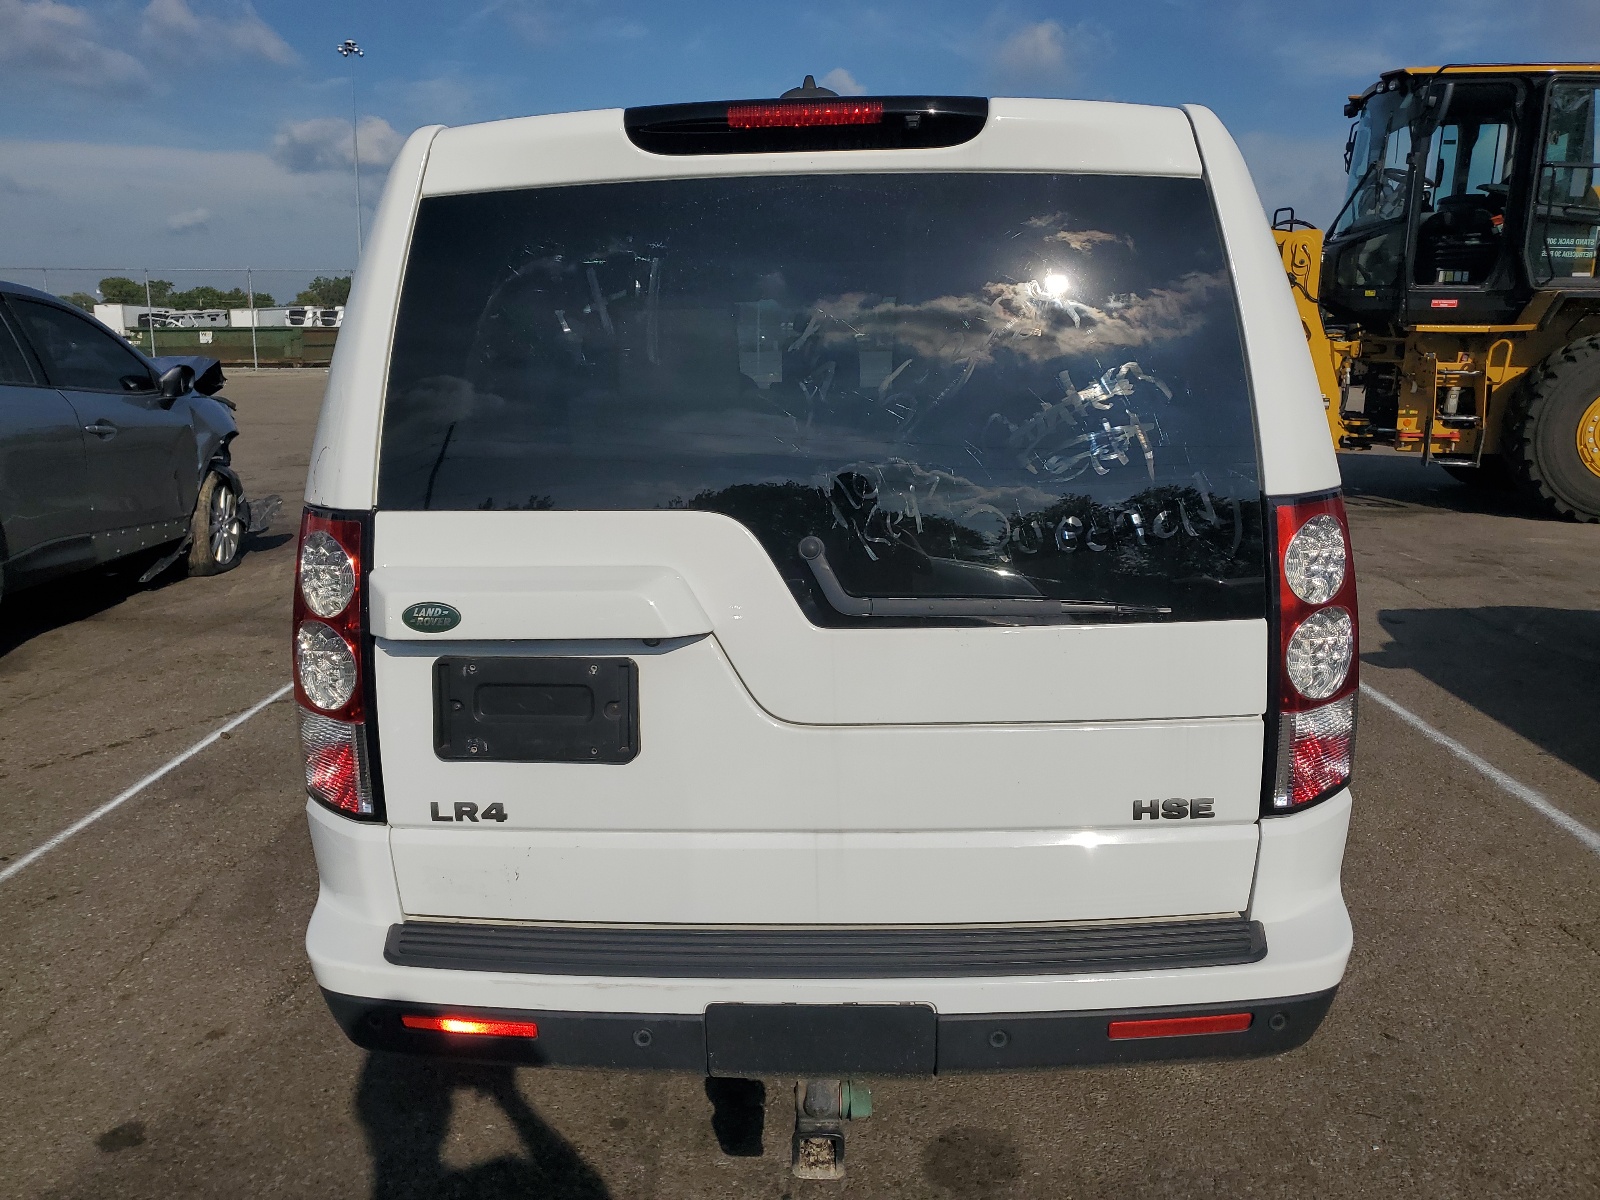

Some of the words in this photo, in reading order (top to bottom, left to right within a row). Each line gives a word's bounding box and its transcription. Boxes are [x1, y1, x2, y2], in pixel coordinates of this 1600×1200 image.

[413, 607, 442, 617] LAND
[416, 617, 451, 626] ROVER
[430, 801, 508, 822] LR4
[1132, 797, 1215, 821] HSE
